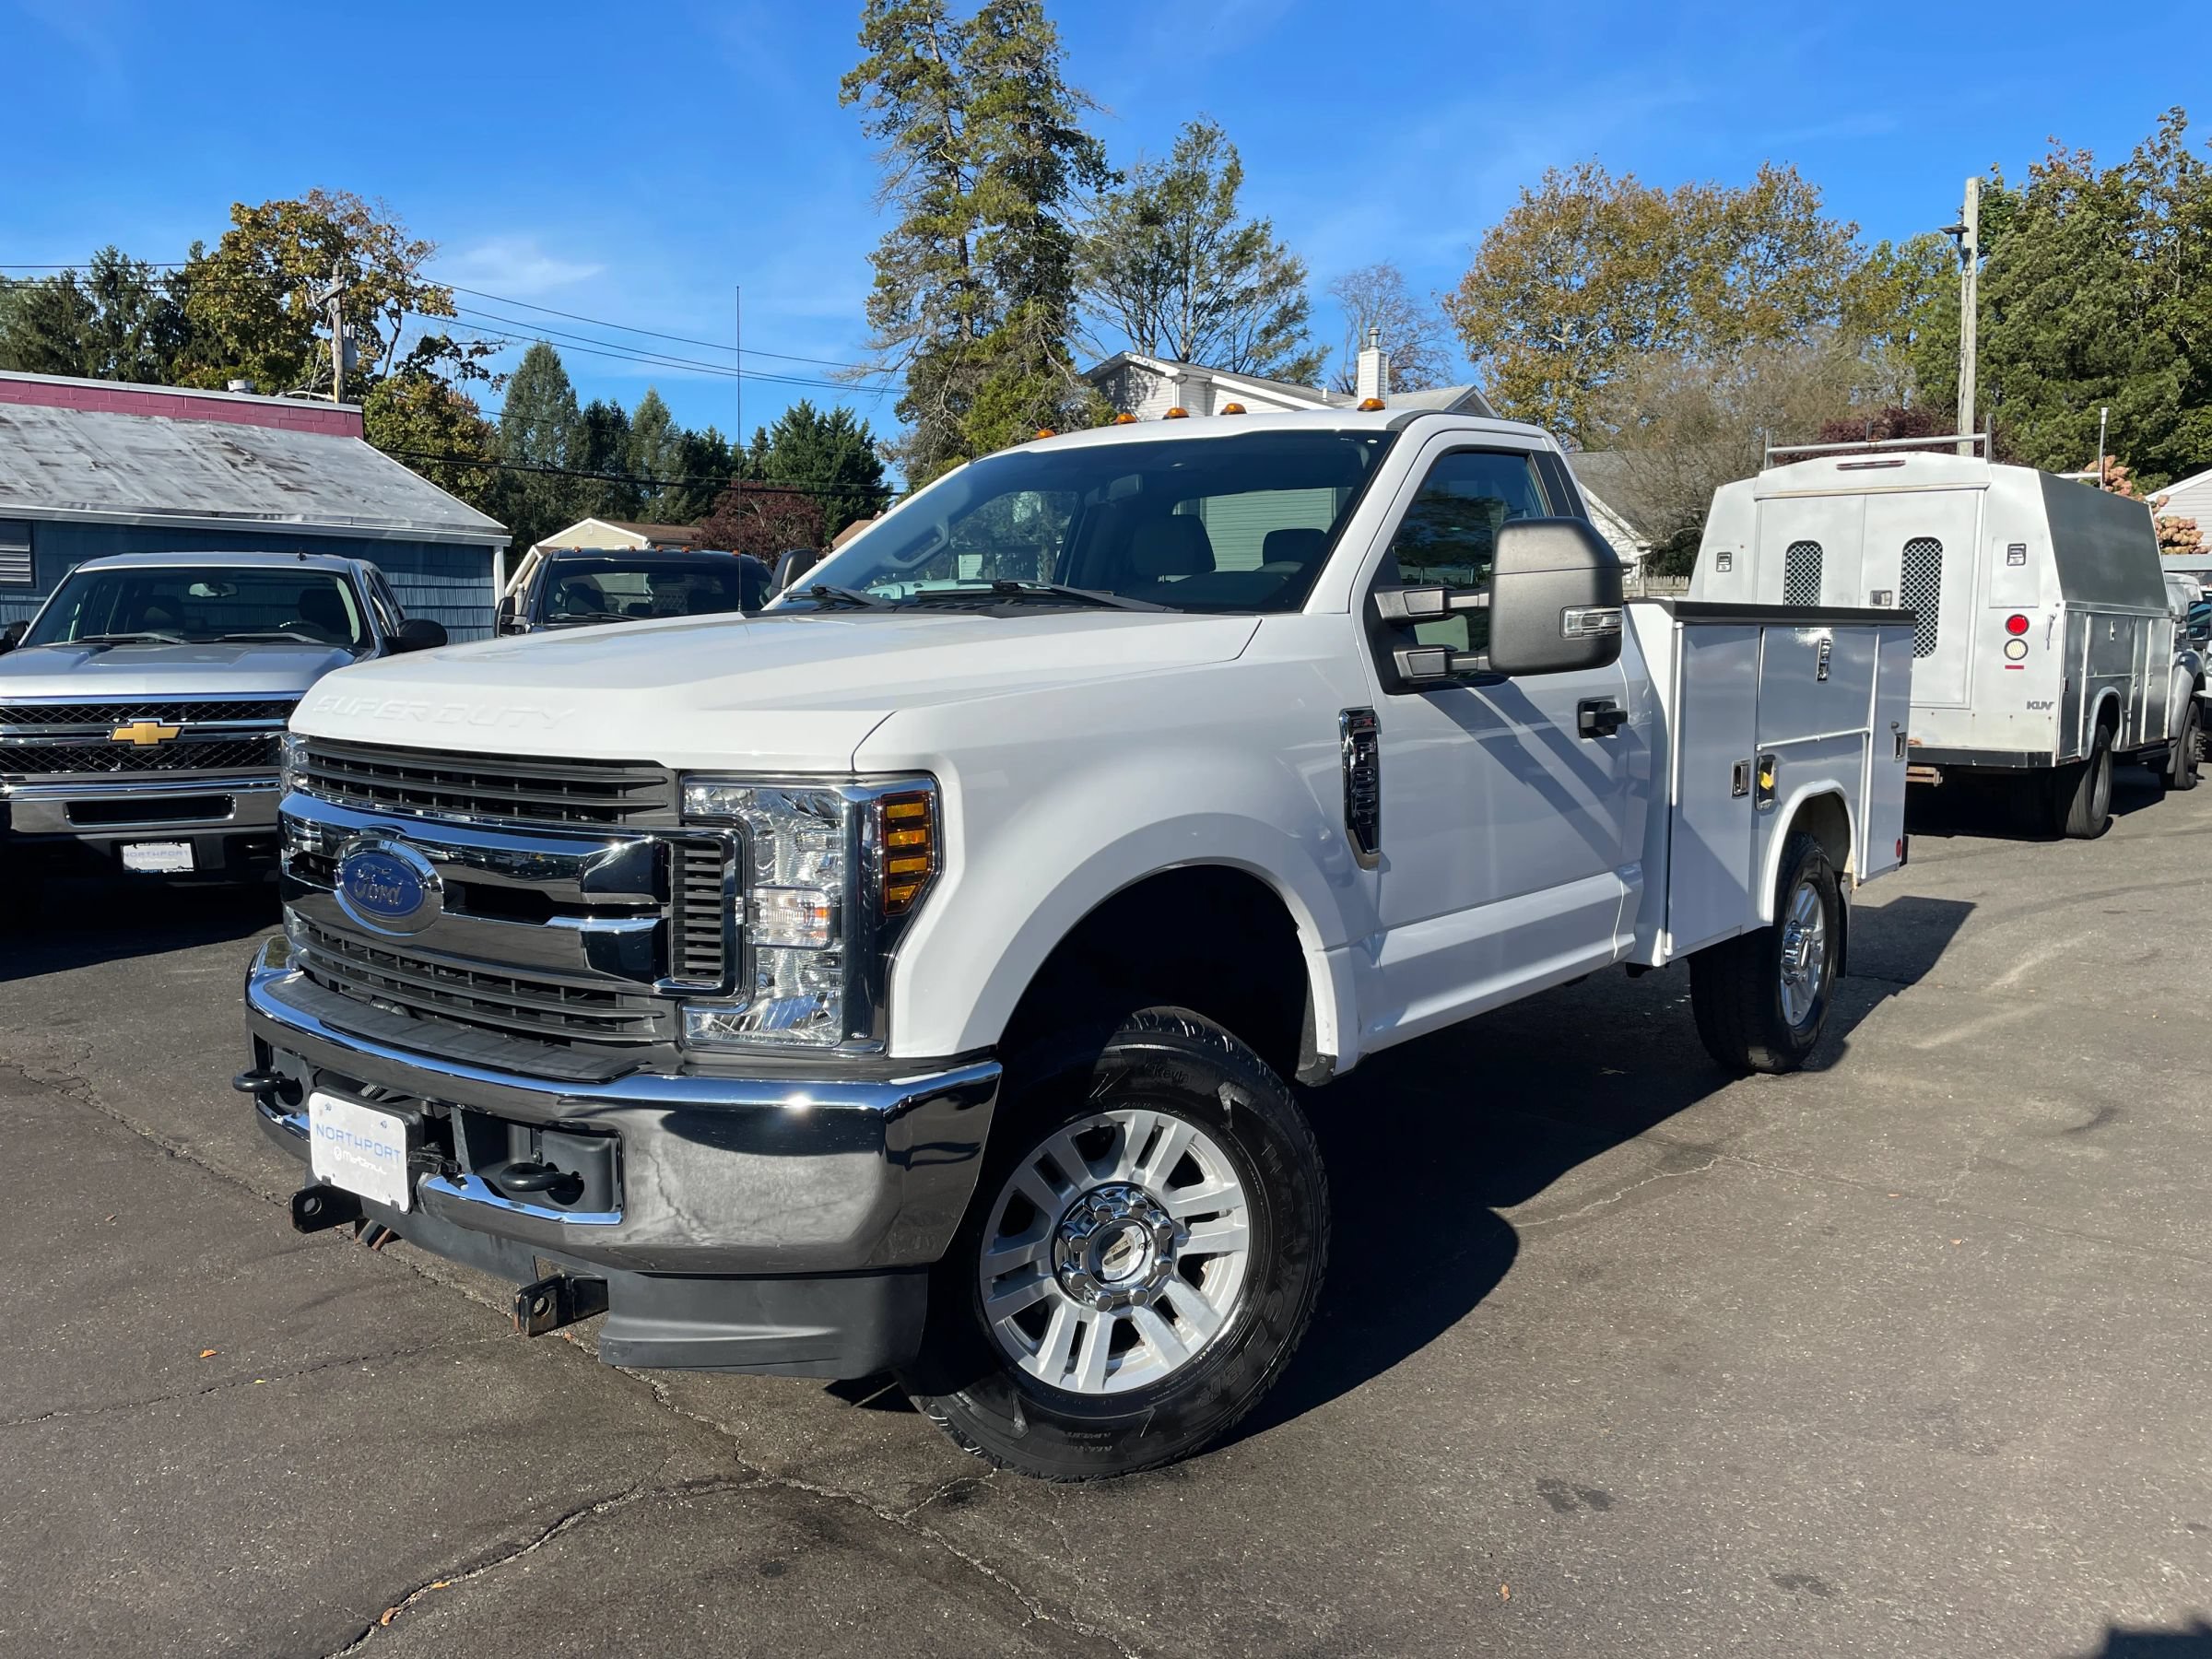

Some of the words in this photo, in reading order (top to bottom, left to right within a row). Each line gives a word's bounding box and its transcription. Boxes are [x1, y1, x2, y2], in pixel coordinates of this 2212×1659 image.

[313, 695, 431, 722] SUPER
[433, 702, 575, 729] DUTY
[2027, 700, 2054, 710] KUV
[354, 862, 404, 907] Ford
[315, 1122, 402, 1164] NORTHPORT
